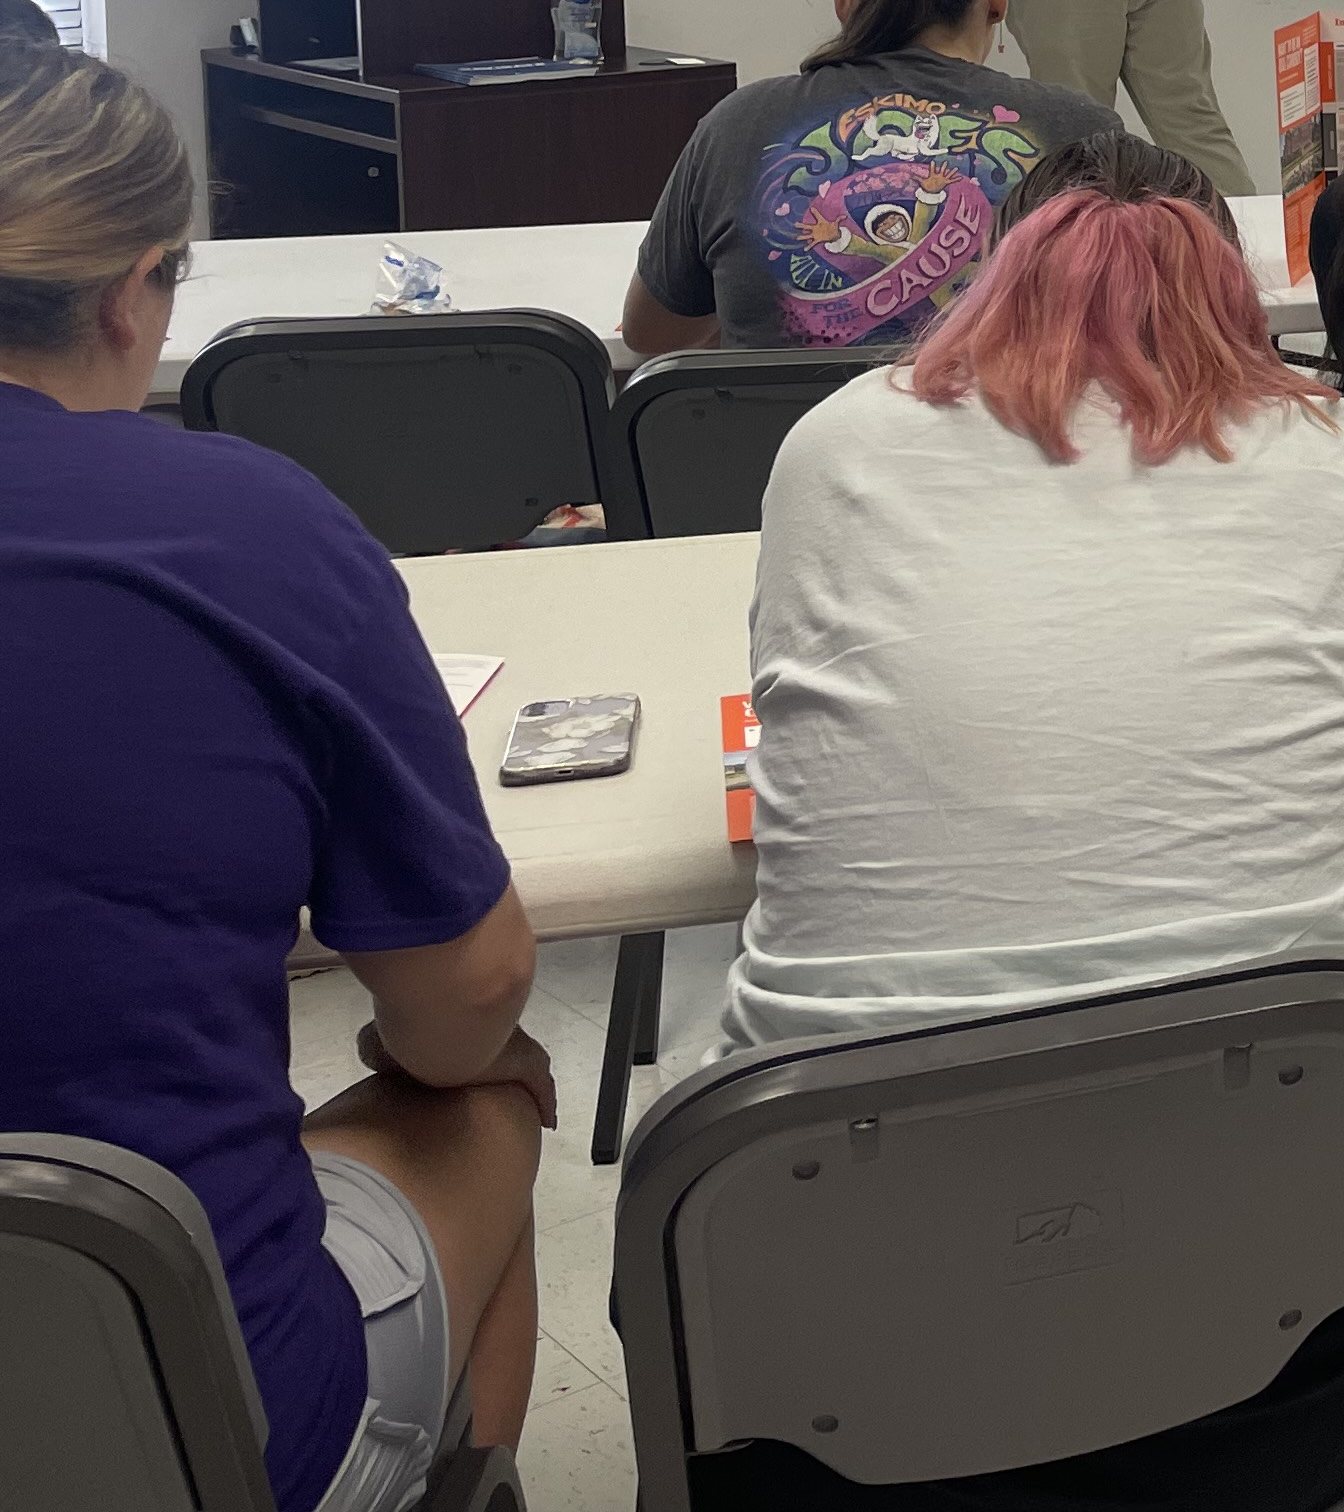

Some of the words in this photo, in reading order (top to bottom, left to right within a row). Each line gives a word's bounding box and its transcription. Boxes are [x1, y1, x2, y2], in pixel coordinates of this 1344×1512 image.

[838, 92, 947, 143] ESKIMO
[789, 253, 821, 289] ALL
[817, 268, 843, 290] IN
[865, 192, 983, 320] CAUSE
[810, 297, 852, 314] FOR
[823, 307, 864, 327] THE
